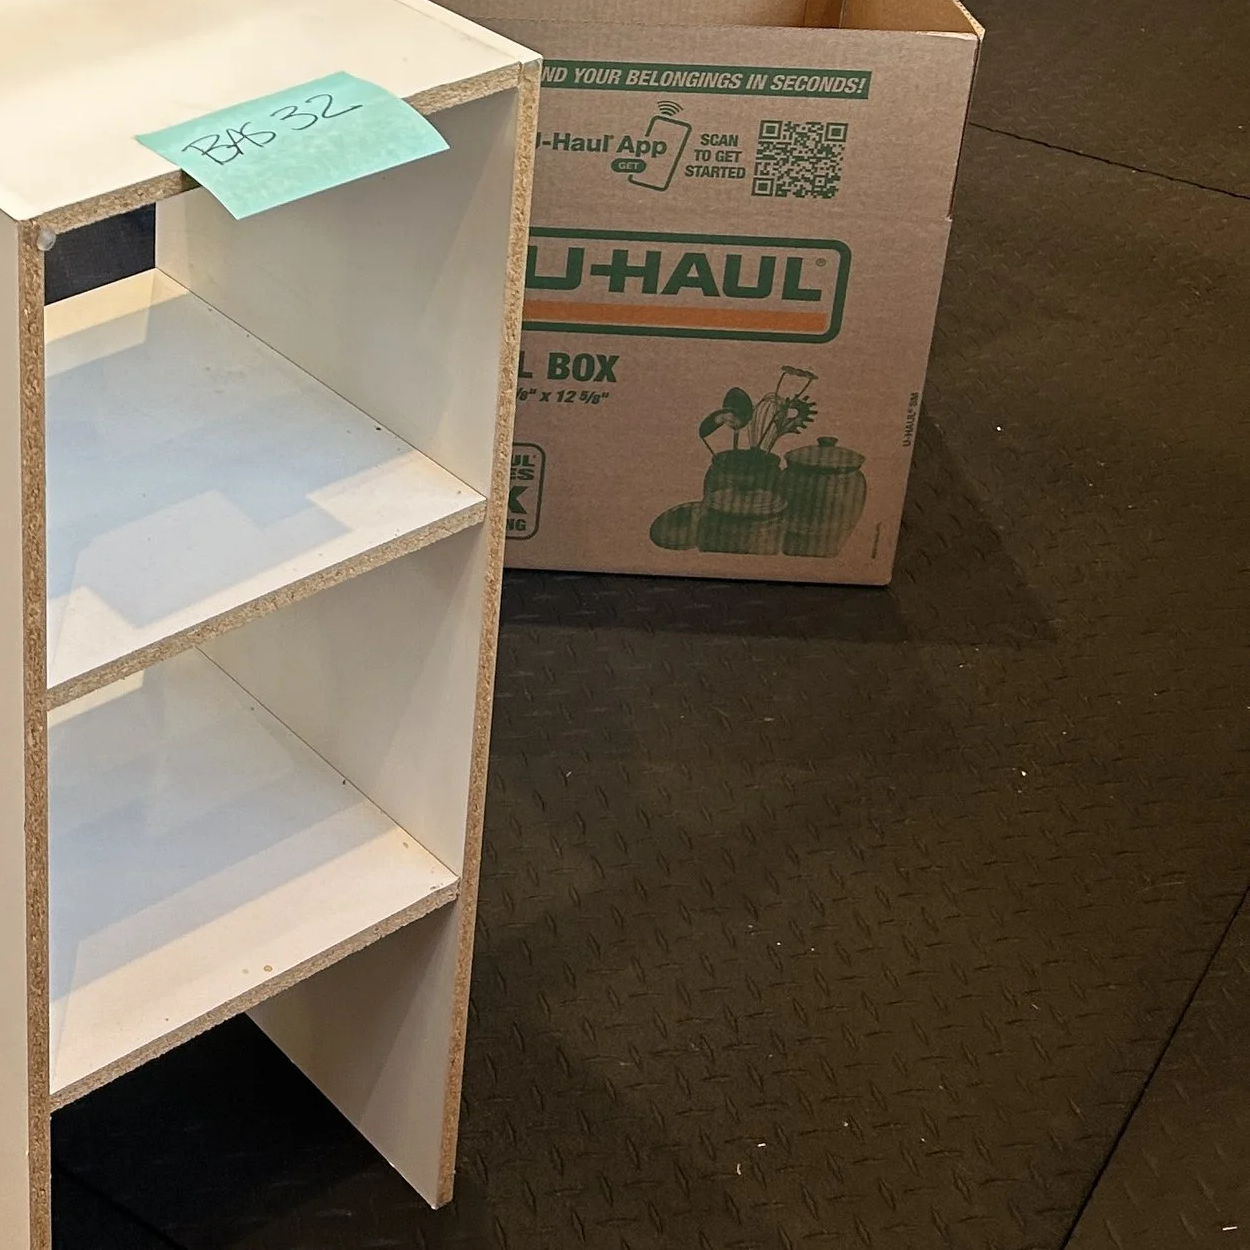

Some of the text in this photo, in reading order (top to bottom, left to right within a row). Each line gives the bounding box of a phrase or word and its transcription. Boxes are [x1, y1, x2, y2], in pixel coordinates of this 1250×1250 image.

[574, 68, 622, 85] YOUR
[626, 70, 743, 89] BELONGINGS
[746, 74, 768, 90] IN
[770, 75, 867, 94] SECONDS!
[181, 93, 363, 165] BAS 32
[615, 135, 668, 158] App
[700, 134, 739, 147] SCAN
[694, 150, 743, 163] TO GET
[618, 162, 639, 170] GET
[684, 165, 746, 179] STARTED
[547, 352, 619, 382] BOX
[539, 392, 552, 402] x
[557, 390, 576, 403] 12
